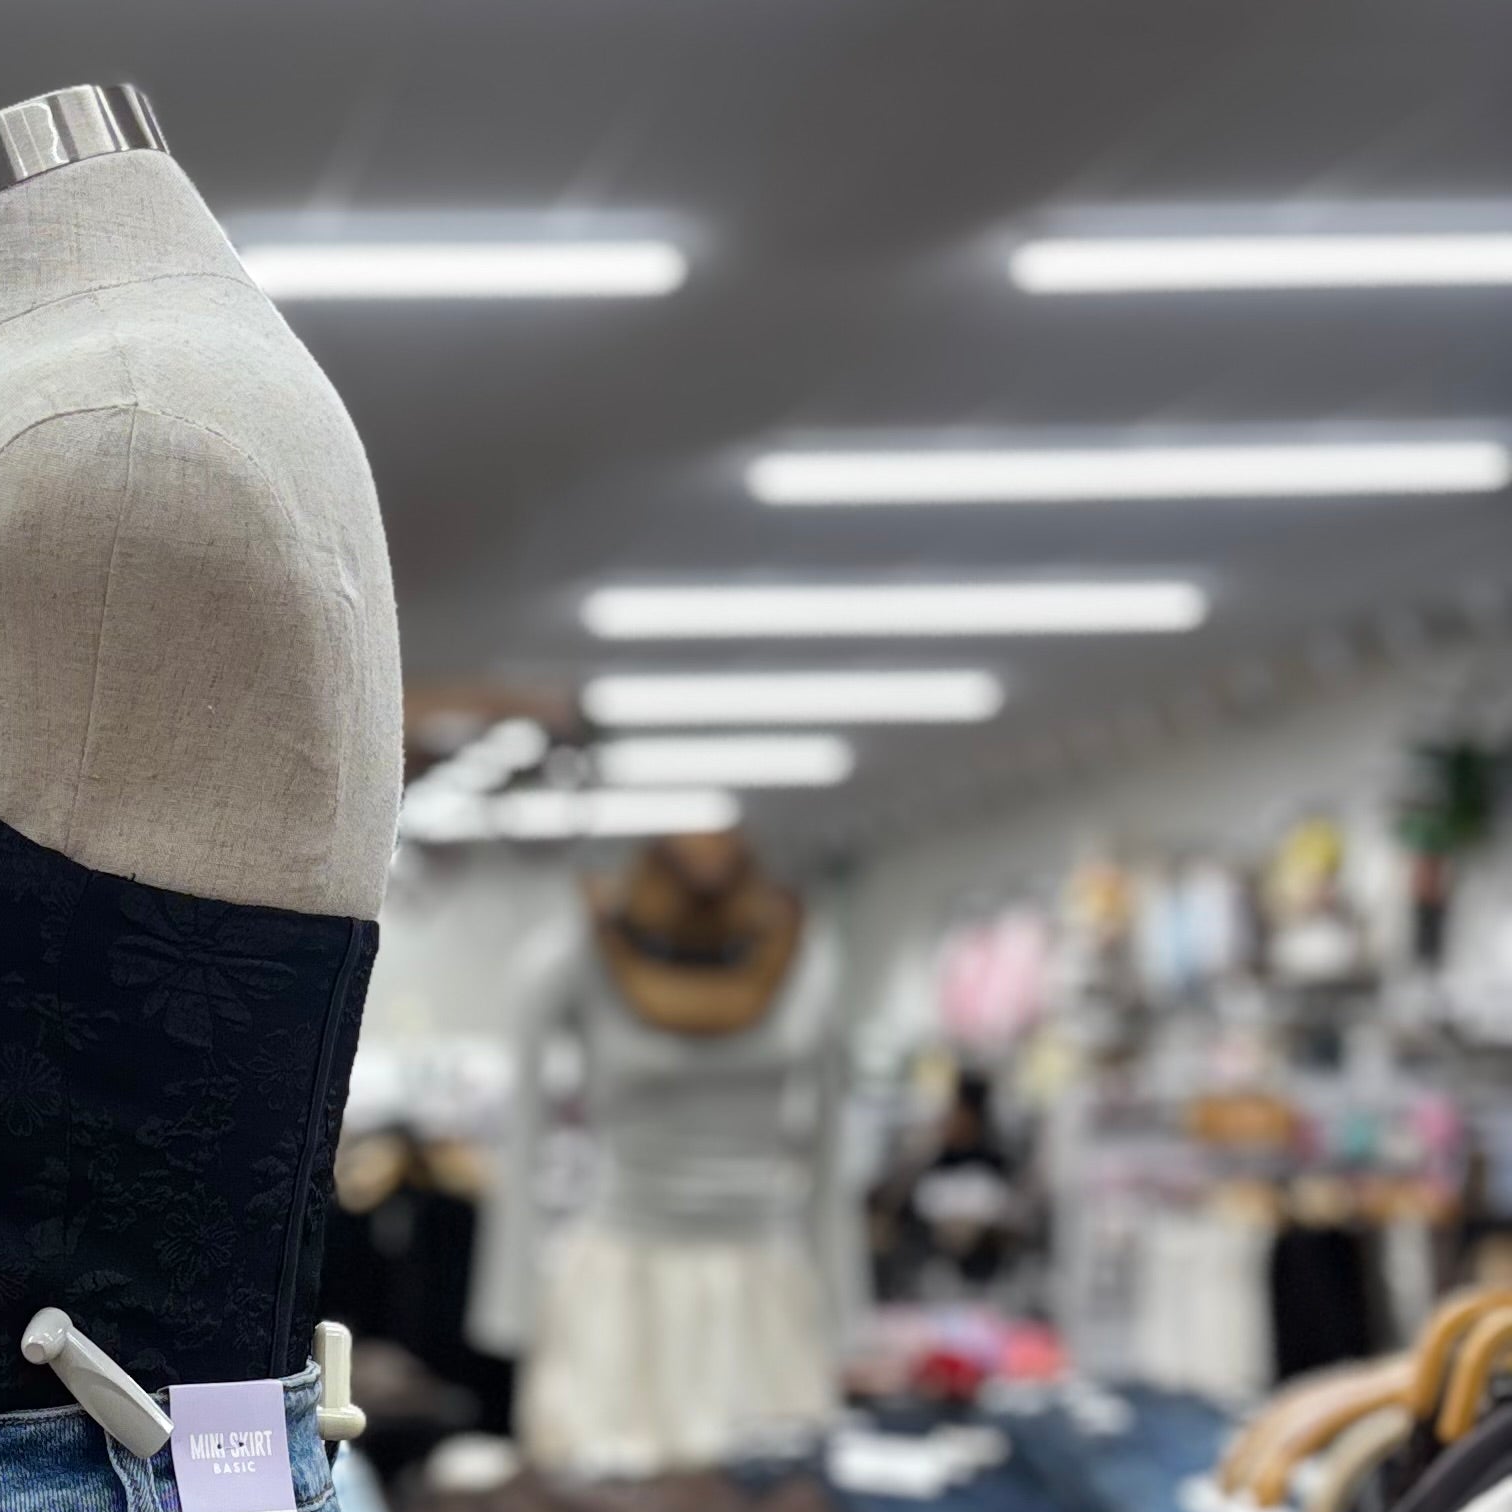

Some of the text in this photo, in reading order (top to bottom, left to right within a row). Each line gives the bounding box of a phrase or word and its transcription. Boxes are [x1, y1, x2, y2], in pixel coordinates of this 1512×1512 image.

[190, 1430, 273, 1460] MINI SKIRT
[213, 1461, 256, 1474] BASIC
